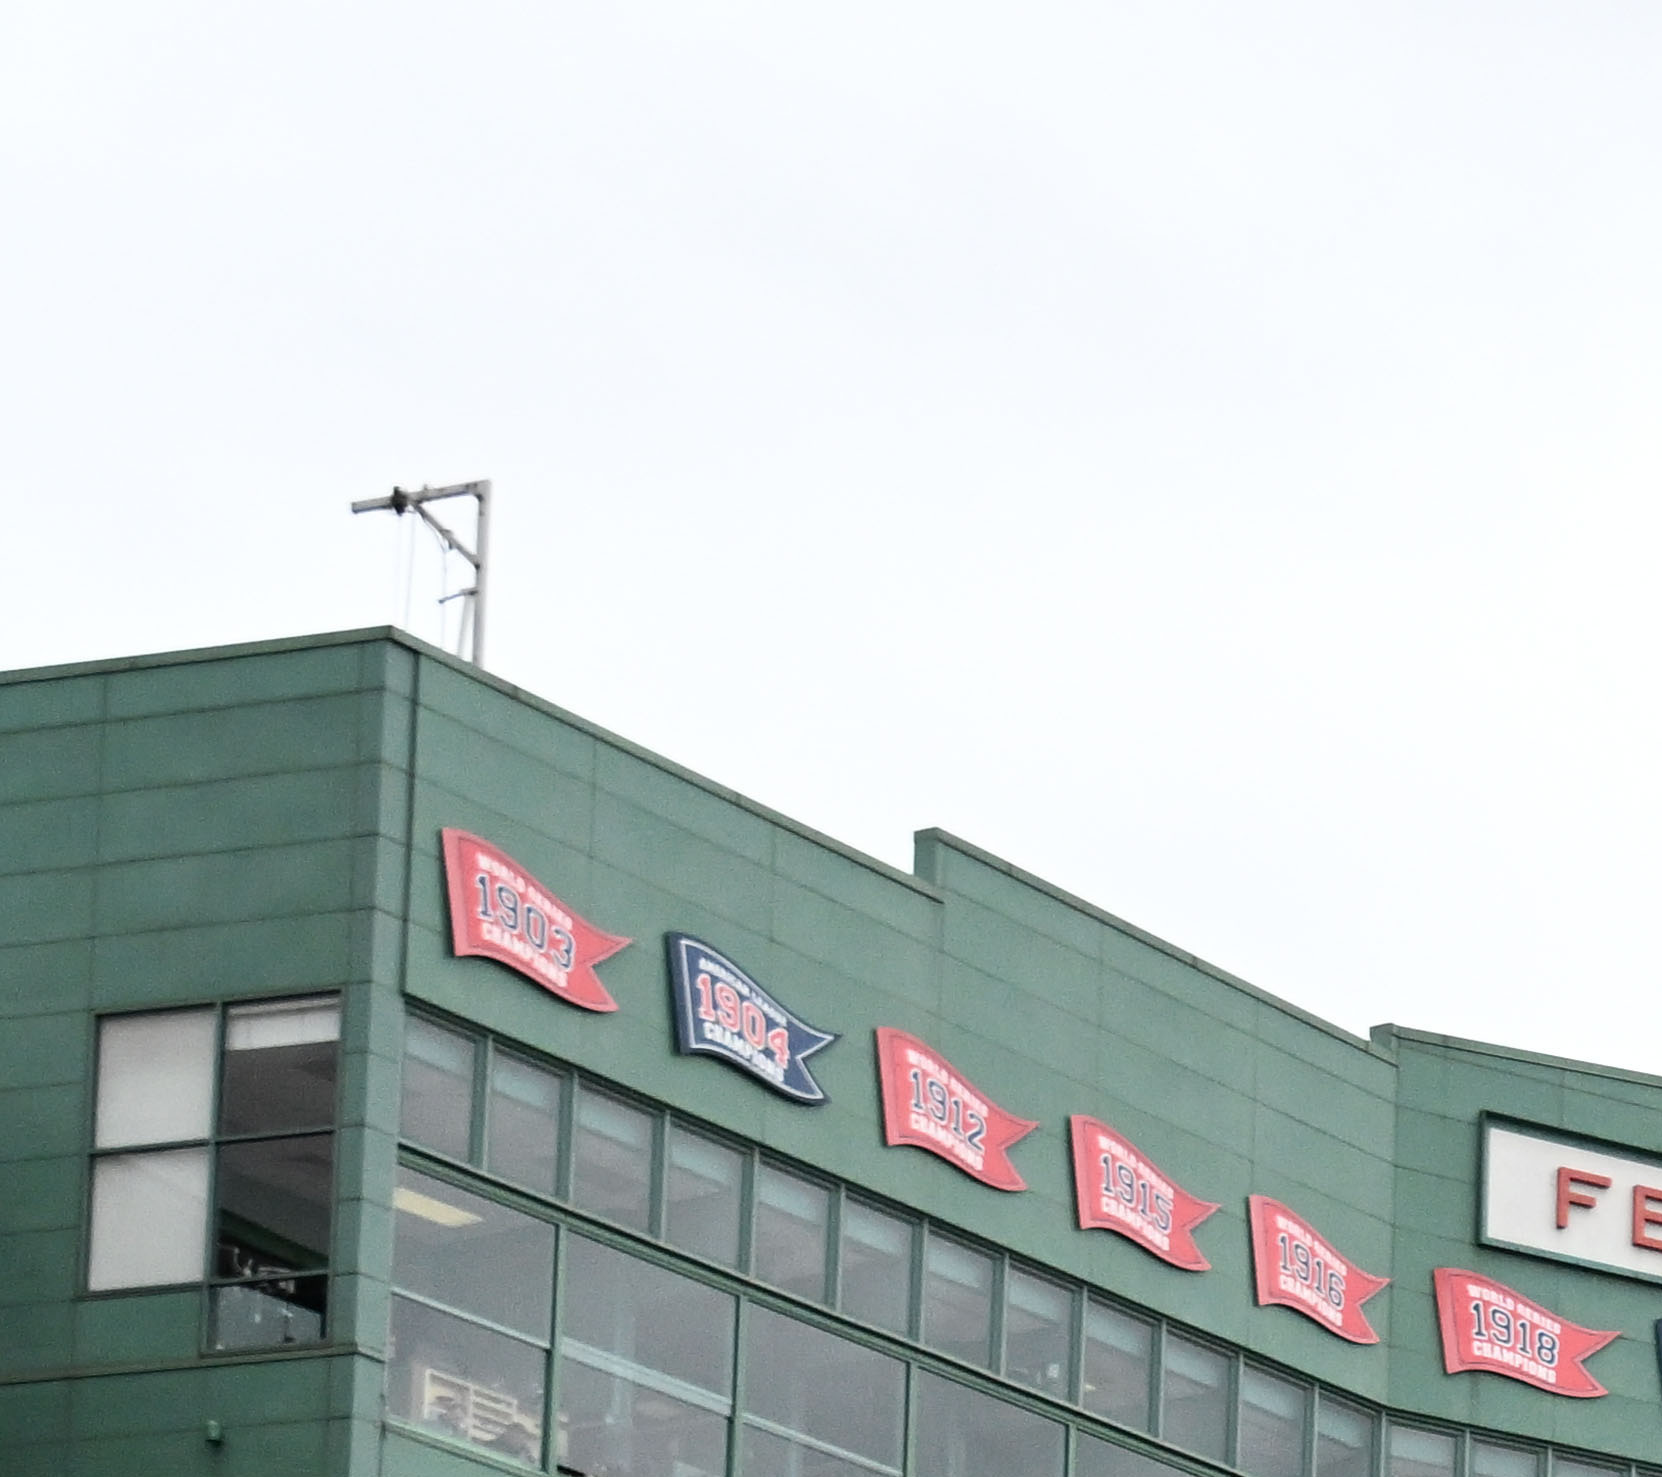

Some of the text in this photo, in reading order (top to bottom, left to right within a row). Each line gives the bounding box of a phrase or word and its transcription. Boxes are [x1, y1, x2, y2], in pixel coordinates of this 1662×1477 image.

[475, 874, 575, 971] 1903
[696, 973, 789, 1069] 1904
[910, 1113, 983, 1171] CHAMPIONS
[911, 1069, 986, 1152] 1912
[1100, 1154, 1172, 1234] 1915
[1102, 1197, 1170, 1251] CHAMPIONS
[1278, 1234, 1344, 1310] 1916
[1278, 1275, 1343, 1326] CHAMPIONS
[1467, 1284, 1562, 1335] WORLD SERIES
[1471, 1301, 1560, 1367] 1918
[1472, 1340, 1557, 1383] CHAMPIONS
